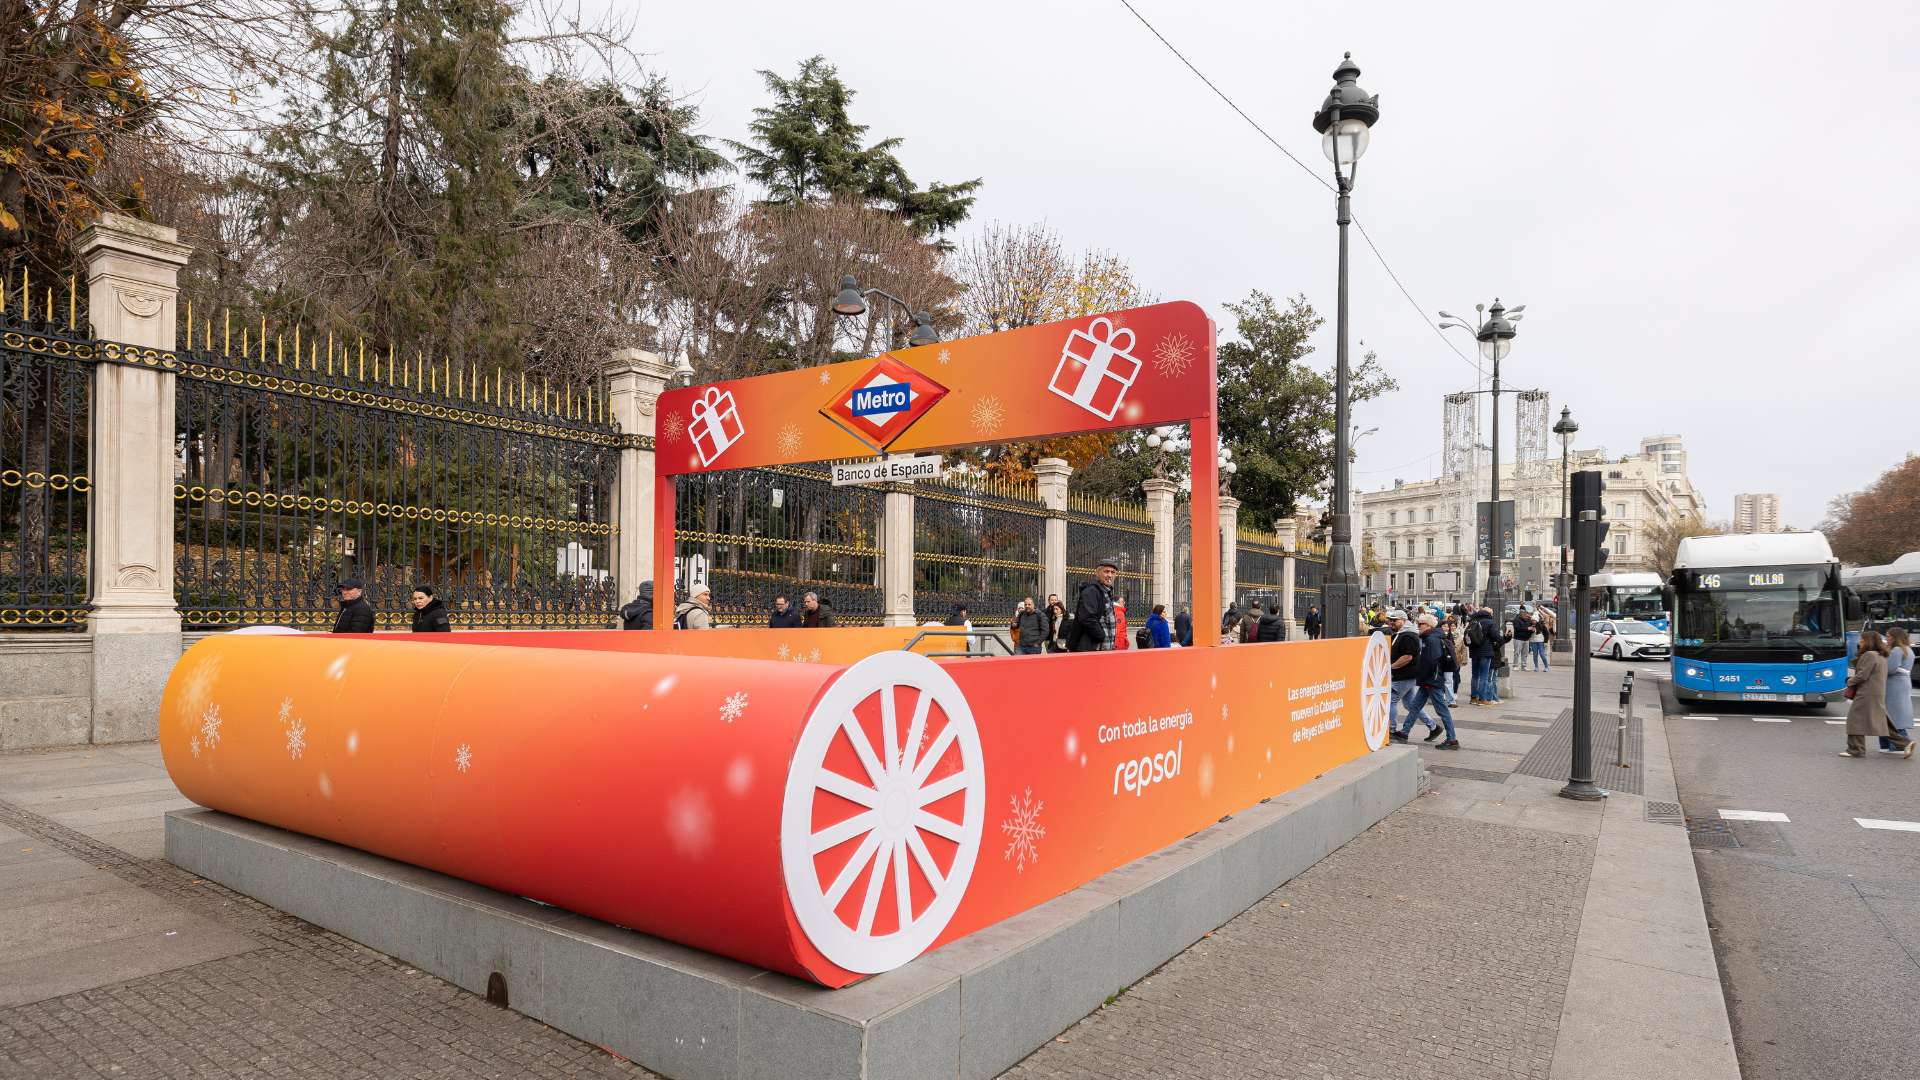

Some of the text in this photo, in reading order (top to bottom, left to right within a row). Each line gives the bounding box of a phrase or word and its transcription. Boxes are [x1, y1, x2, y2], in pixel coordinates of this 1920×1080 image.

[857, 390, 906, 411] Metro
[837, 461, 934, 481] Banco de España
[1699, 574, 1721, 588] 146
[1288, 676, 1346, 701] Las energías de Repsol
[1291, 698, 1344, 722] mueven la Cabalgata
[1098, 708, 1193, 743] Con toda la energía
[1293, 728, 1301, 743] de
[1301, 725, 1318, 742] Reyes
[1317, 720, 1325, 735] de
[1113, 739, 1183, 797] repsol
